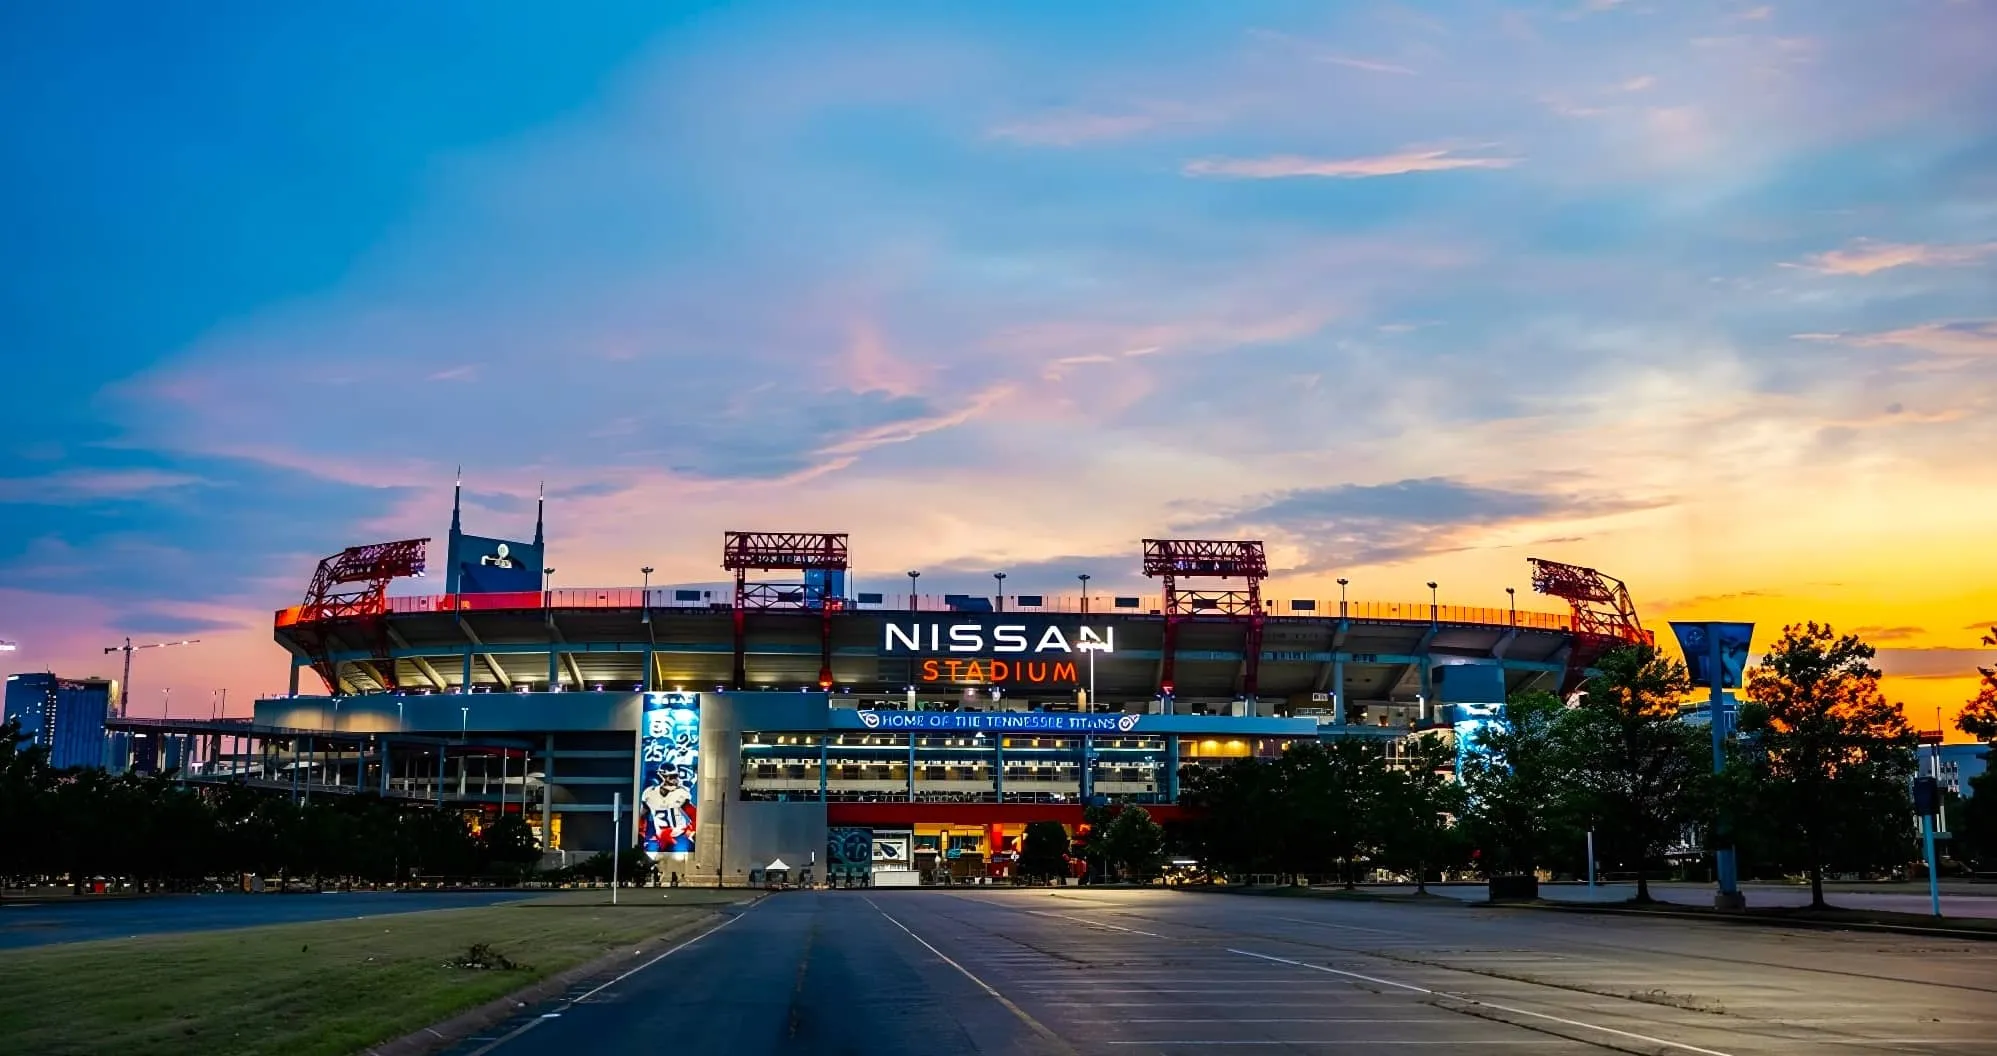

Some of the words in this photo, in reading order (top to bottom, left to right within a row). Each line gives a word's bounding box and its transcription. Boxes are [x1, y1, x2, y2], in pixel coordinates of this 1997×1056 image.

[885, 623, 1114, 653] NISSAN
[922, 660, 1078, 682] STADIUM
[882, 715, 924, 727] HOME
[930, 715, 949, 727] OF
[955, 716, 980, 727] THE
[986, 716, 1063, 729] TENNESSEE
[1068, 717, 1116, 729] TITANS
[645, 745, 663, 762] 25
[655, 808, 677, 829] 31
